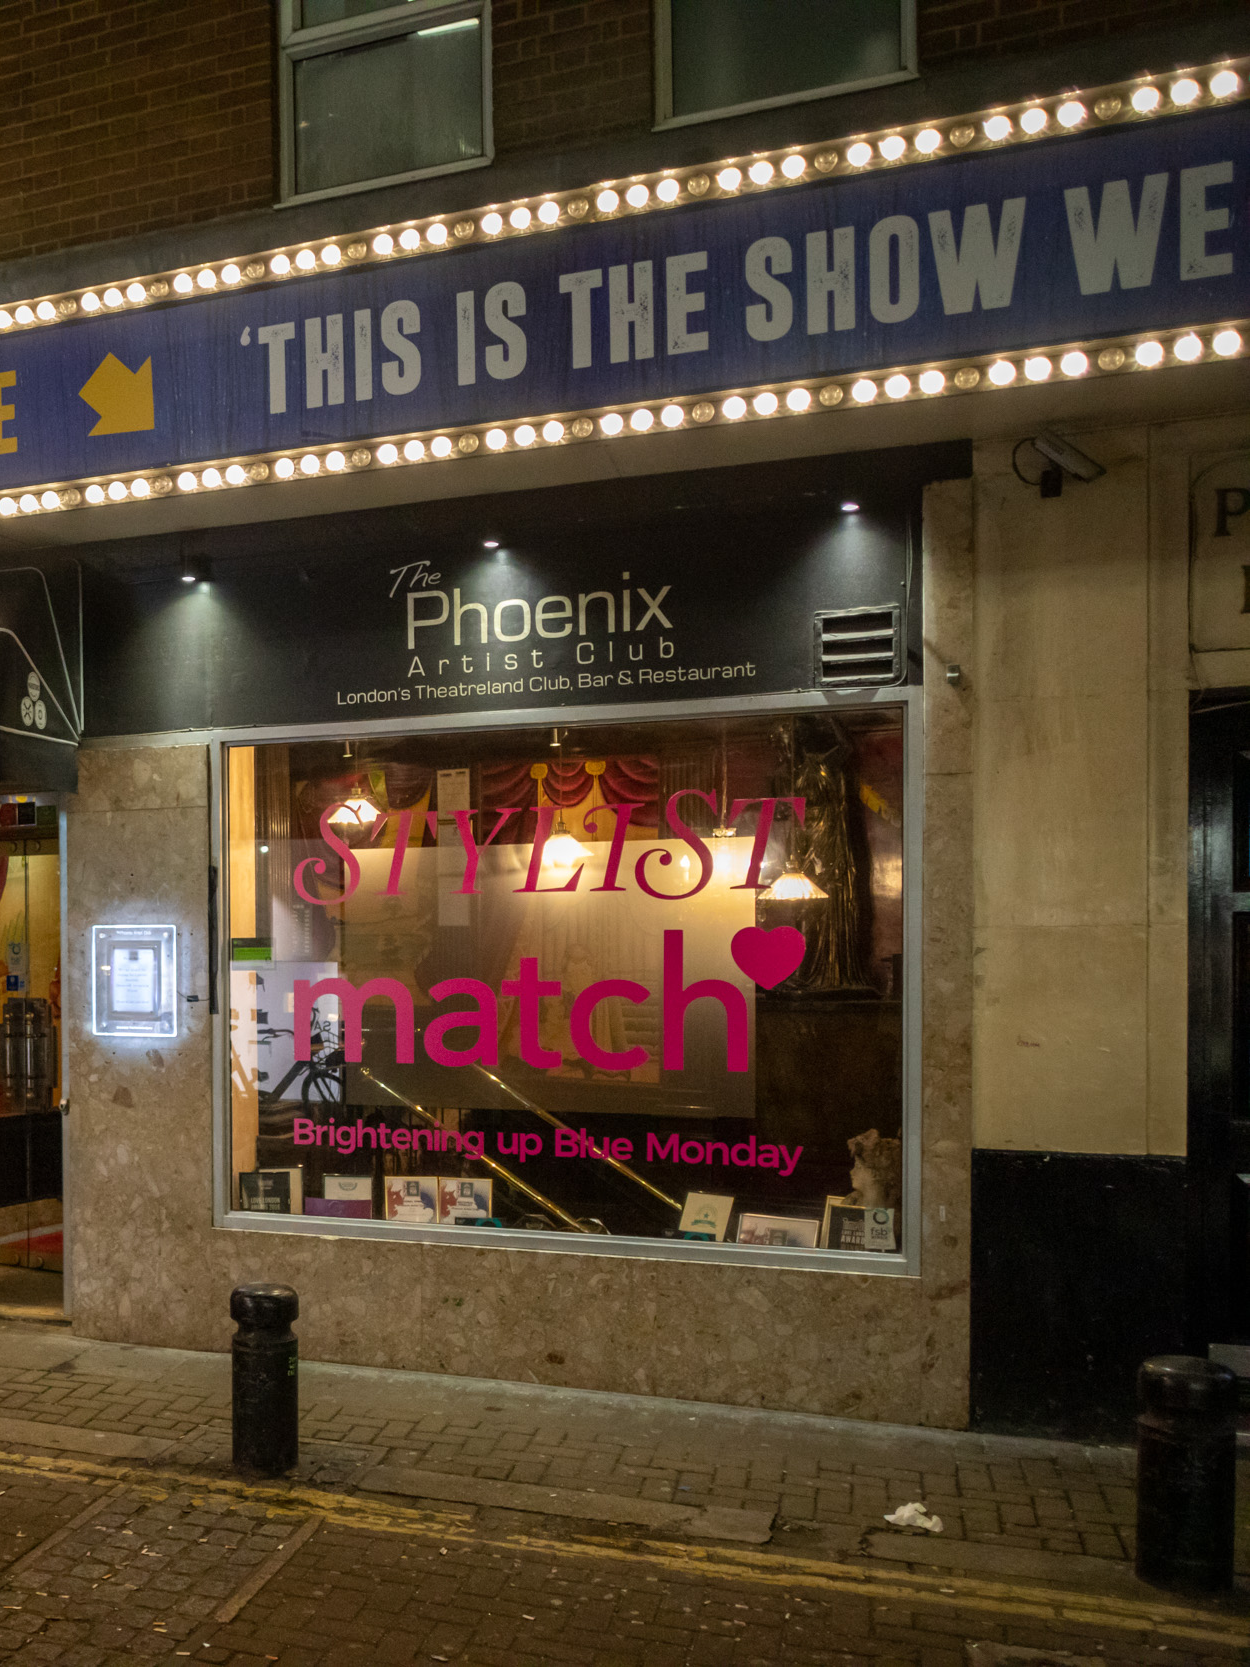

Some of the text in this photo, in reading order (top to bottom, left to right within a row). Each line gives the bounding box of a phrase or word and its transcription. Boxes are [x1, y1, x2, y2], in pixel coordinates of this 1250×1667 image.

[456, 281, 527, 386] IS
[559, 251, 710, 368] THE
[742, 197, 1027, 343] SHOW
[1065, 160, 1234, 296] WE
[389, 560, 443, 599] The
[406, 571, 674, 650] Phoenix
[337, 661, 756, 705] London's Theatreland Club, Bar & Restaurant
[407, 637, 675, 678] Artist Club
[293, 789, 807, 906] STYLIST
[293, 928, 751, 1072] match
[293, 1117, 804, 1177] Brightening up Blue Monday
[870, 1227, 888, 1237] fsb
